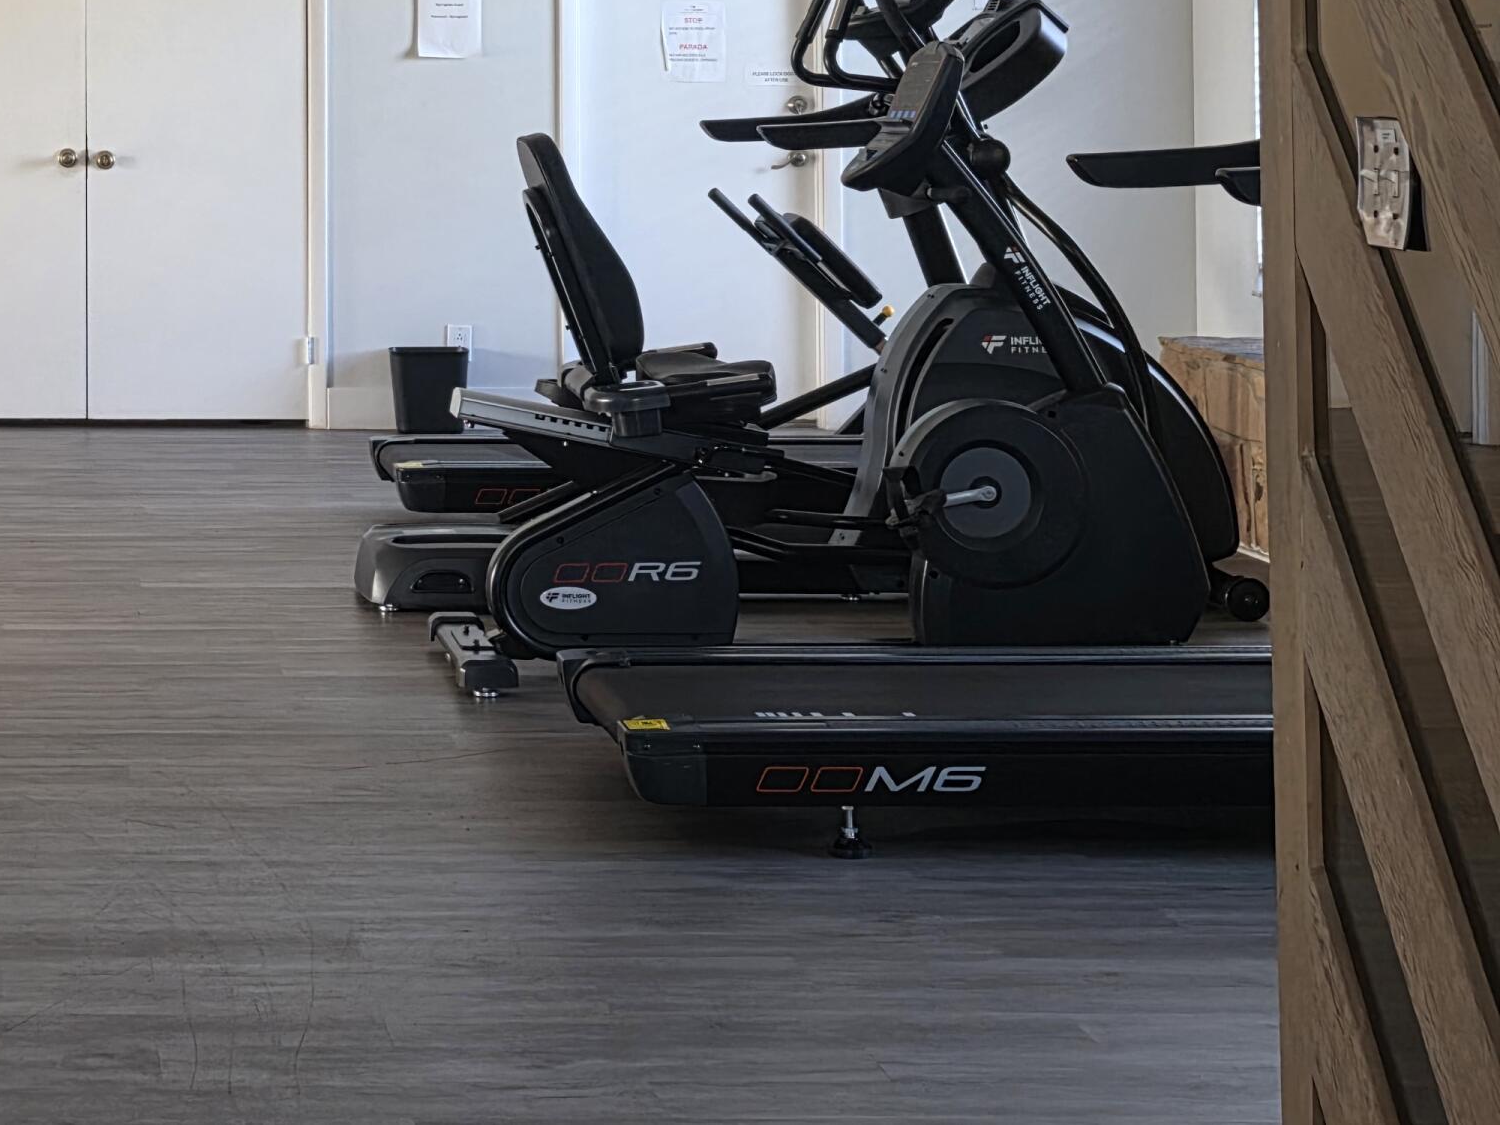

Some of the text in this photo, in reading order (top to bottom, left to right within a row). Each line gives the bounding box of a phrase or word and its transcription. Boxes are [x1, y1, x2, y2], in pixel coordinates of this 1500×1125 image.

[1014, 269, 1043, 310] FITNESS
[1021, 265, 1051, 305] INFLIGHT
[1010, 336, 1042, 345] INFLI
